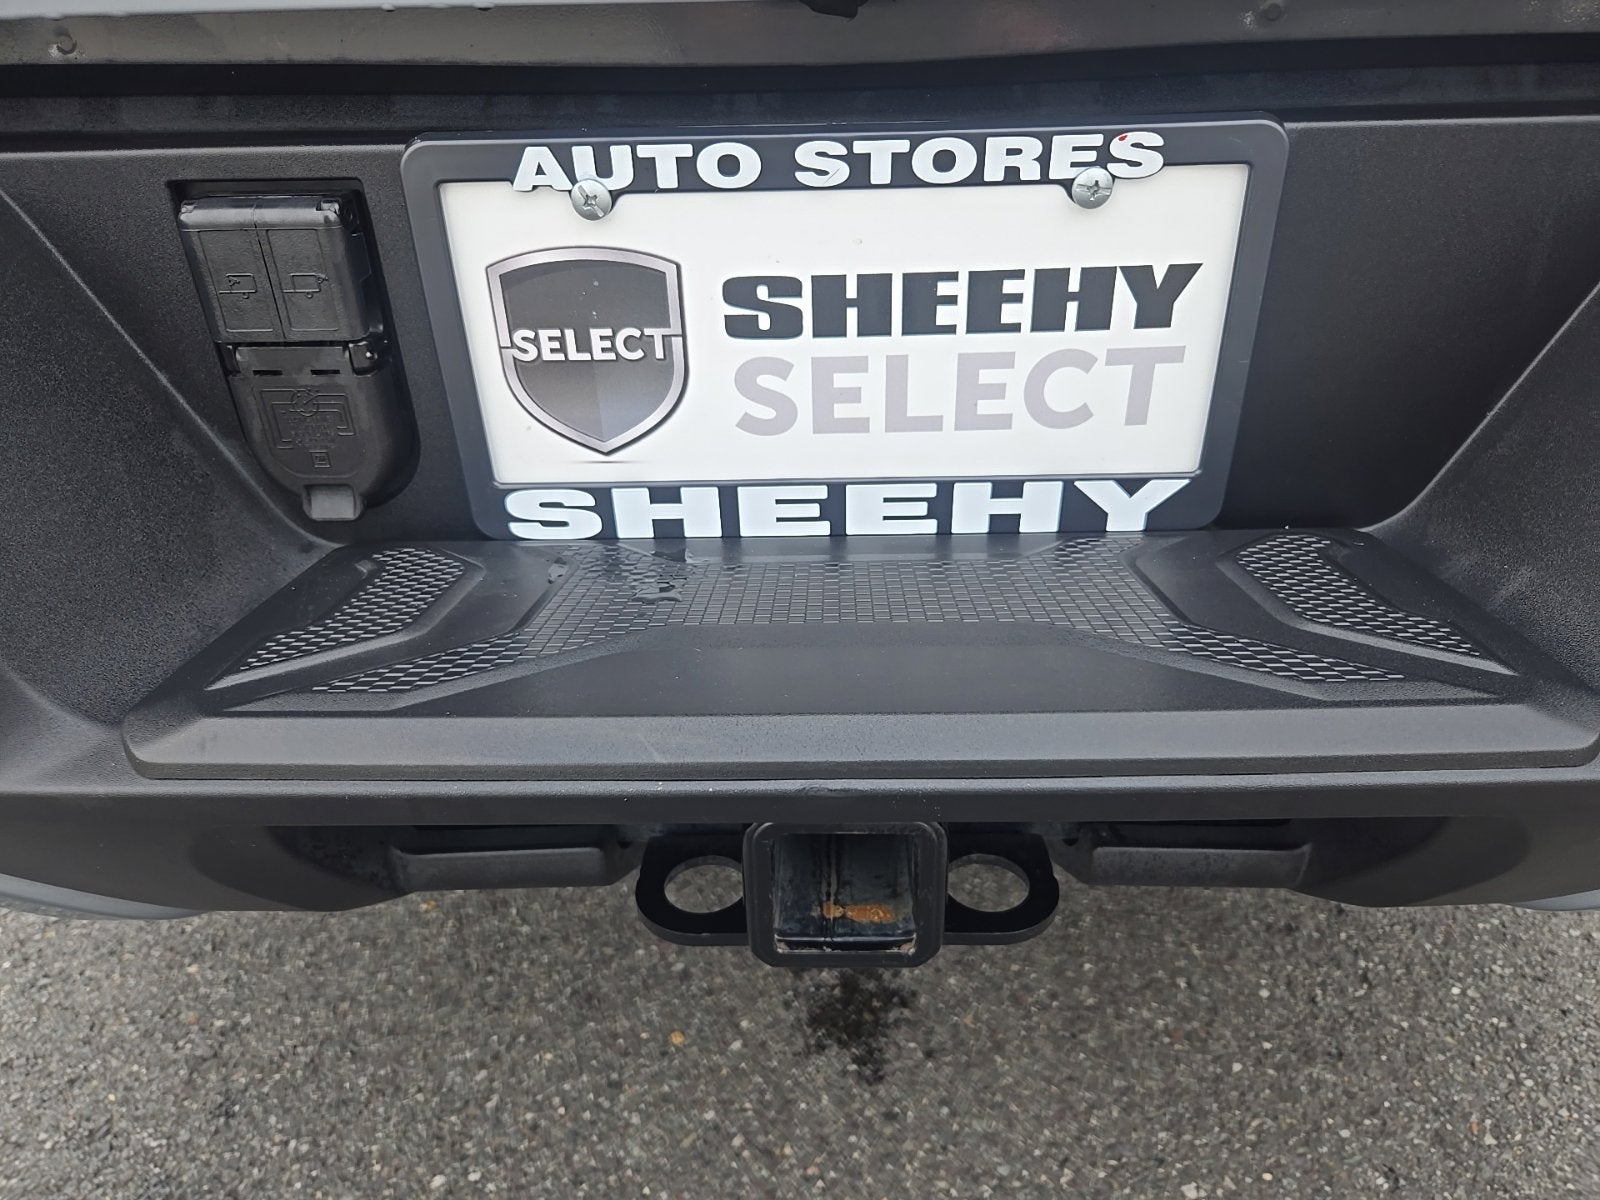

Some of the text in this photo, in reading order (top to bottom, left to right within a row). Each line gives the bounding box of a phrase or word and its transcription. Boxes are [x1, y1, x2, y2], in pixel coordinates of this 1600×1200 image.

[512, 131, 1165, 192] AUTO STORES
[721, 263, 1202, 338] SHEEHY
[511, 327, 668, 362] SELECT
[735, 347, 1185, 436] SELECT
[504, 479, 1191, 539] SHEEHY
